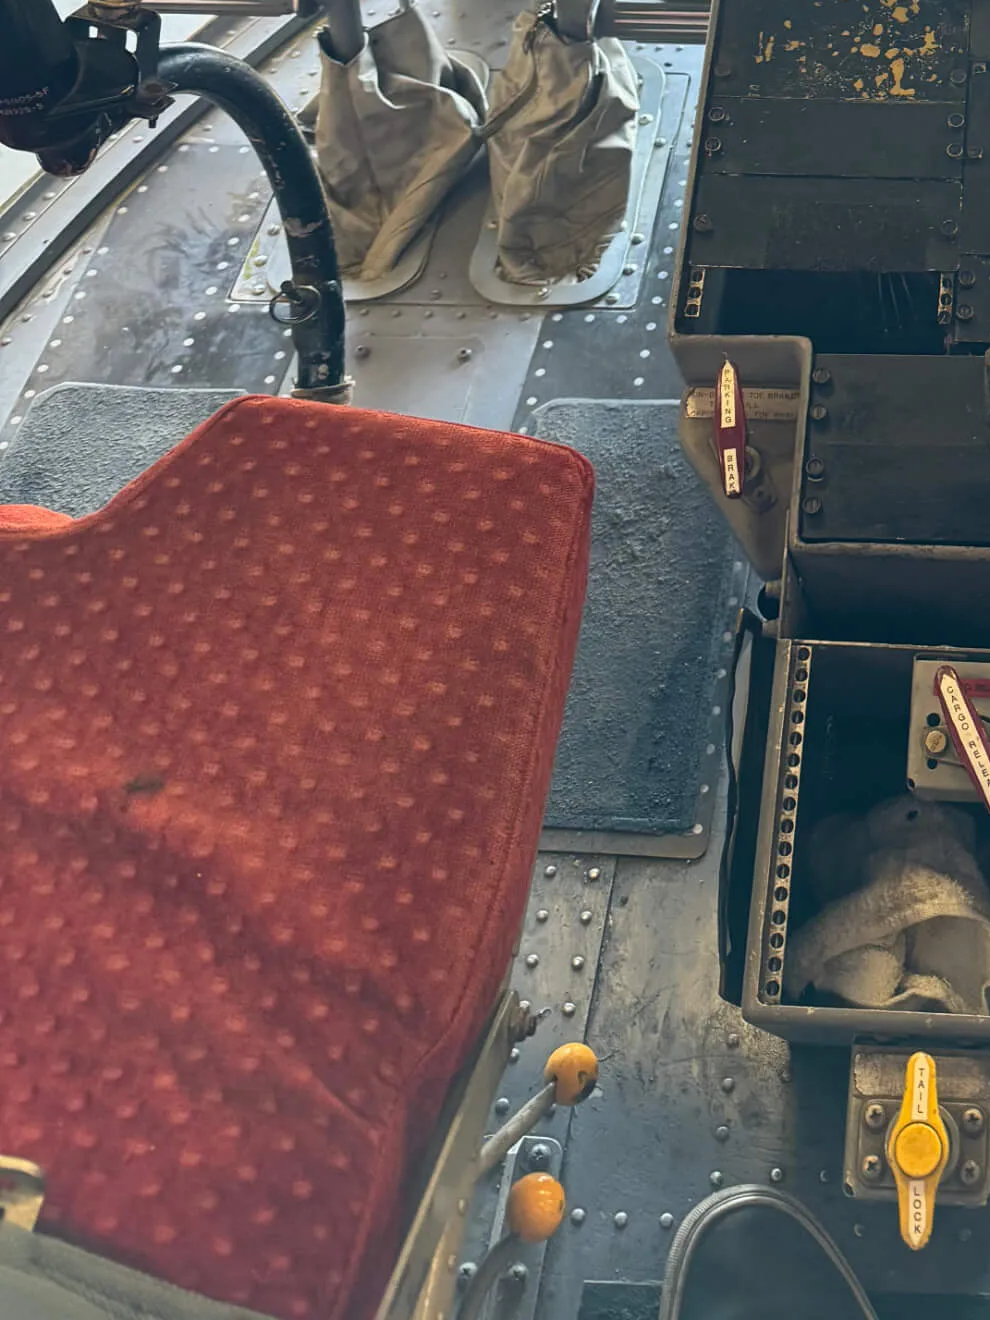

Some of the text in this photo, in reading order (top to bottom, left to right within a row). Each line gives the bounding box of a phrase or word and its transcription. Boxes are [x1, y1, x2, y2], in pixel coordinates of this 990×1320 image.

[724, 368, 732, 423] PARKING
[946, 686, 970, 731] CARGO
[917, 1067, 925, 1114] TAIL
[913, 1186, 921, 1233] LOCK
